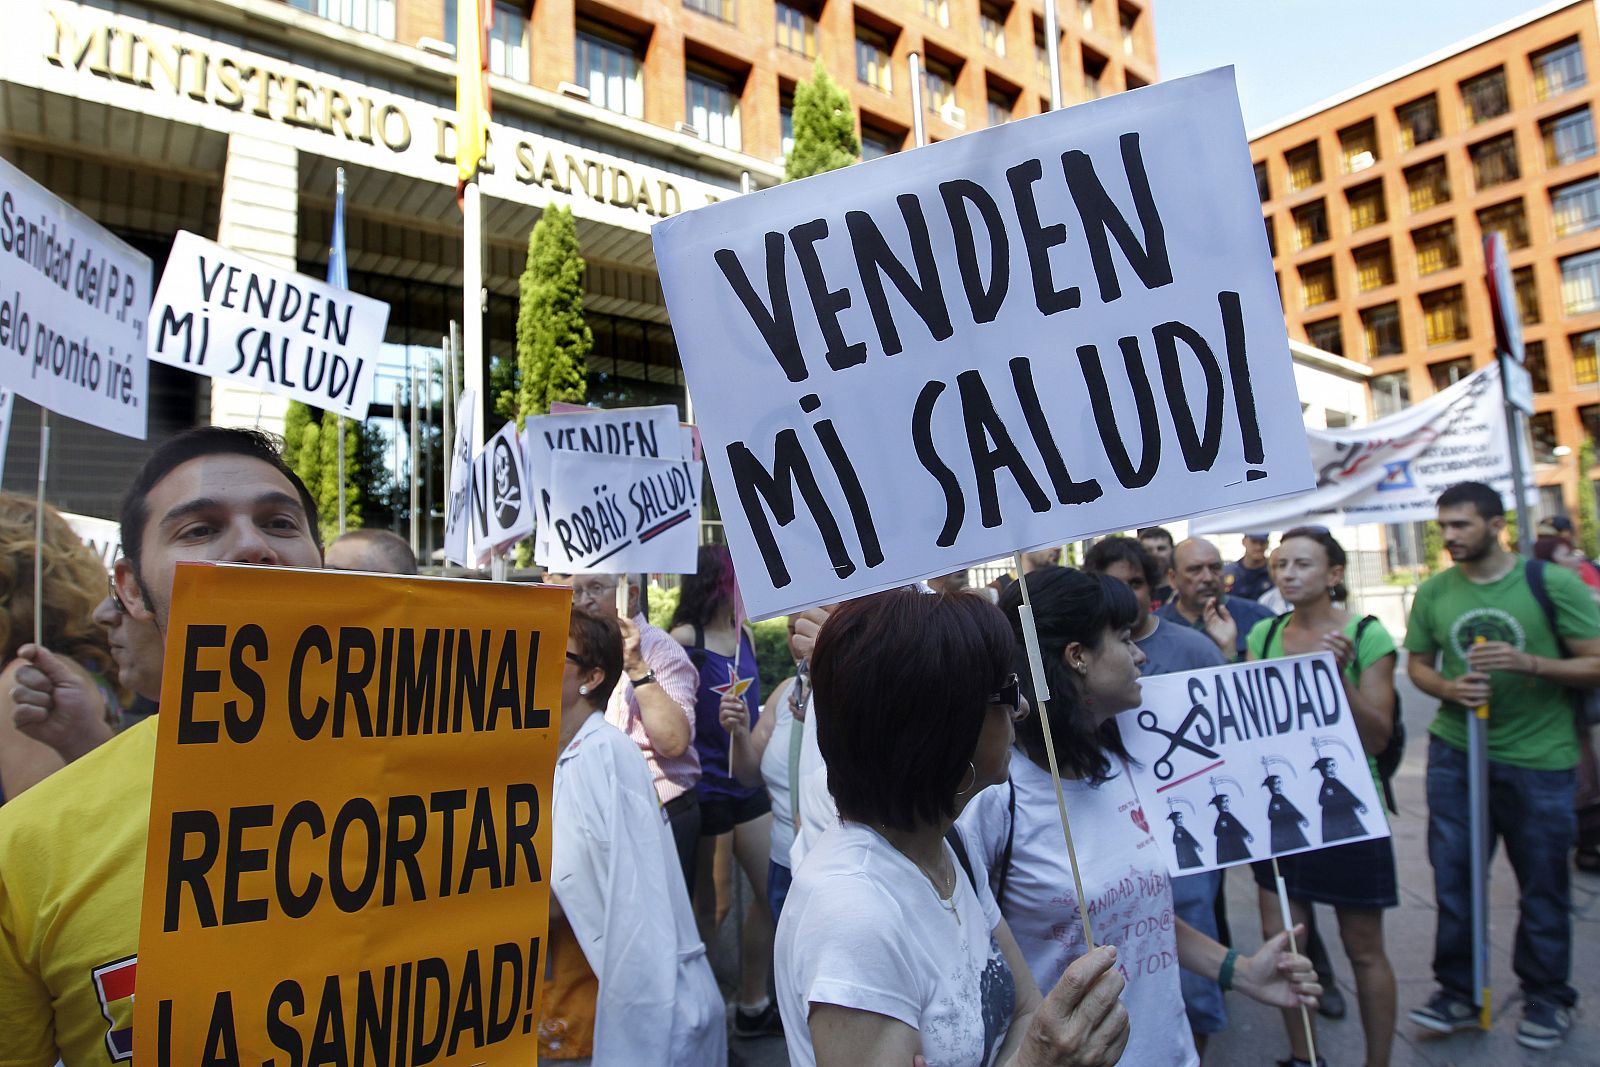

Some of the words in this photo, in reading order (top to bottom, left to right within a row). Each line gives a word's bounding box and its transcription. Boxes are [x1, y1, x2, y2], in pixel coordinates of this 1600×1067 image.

[46, 10, 413, 154] MINISTERIO
[514, 140, 682, 219] SANIDAD
[0, 190, 73, 291] Sanidad
[75, 247, 101, 306] del
[199, 255, 354, 347] VENDEN
[713, 132, 1174, 384] VENDEN
[32, 321, 102, 392] pronto
[106, 346, 139, 408] iré.
[227, 327, 364, 411] SALUD!
[911, 290, 1269, 548] SALUD!
[627, 460, 699, 534] SALUD!
[176, 622, 270, 746] ES
[287, 623, 551, 742] CRIMINAL
[1186, 658, 1342, 749] SANIDAD
[162, 782, 542, 933] RECORTAR
[1070, 877, 1135, 921] SANIDAD
[261, 936, 540, 1067] SANIDAD!
